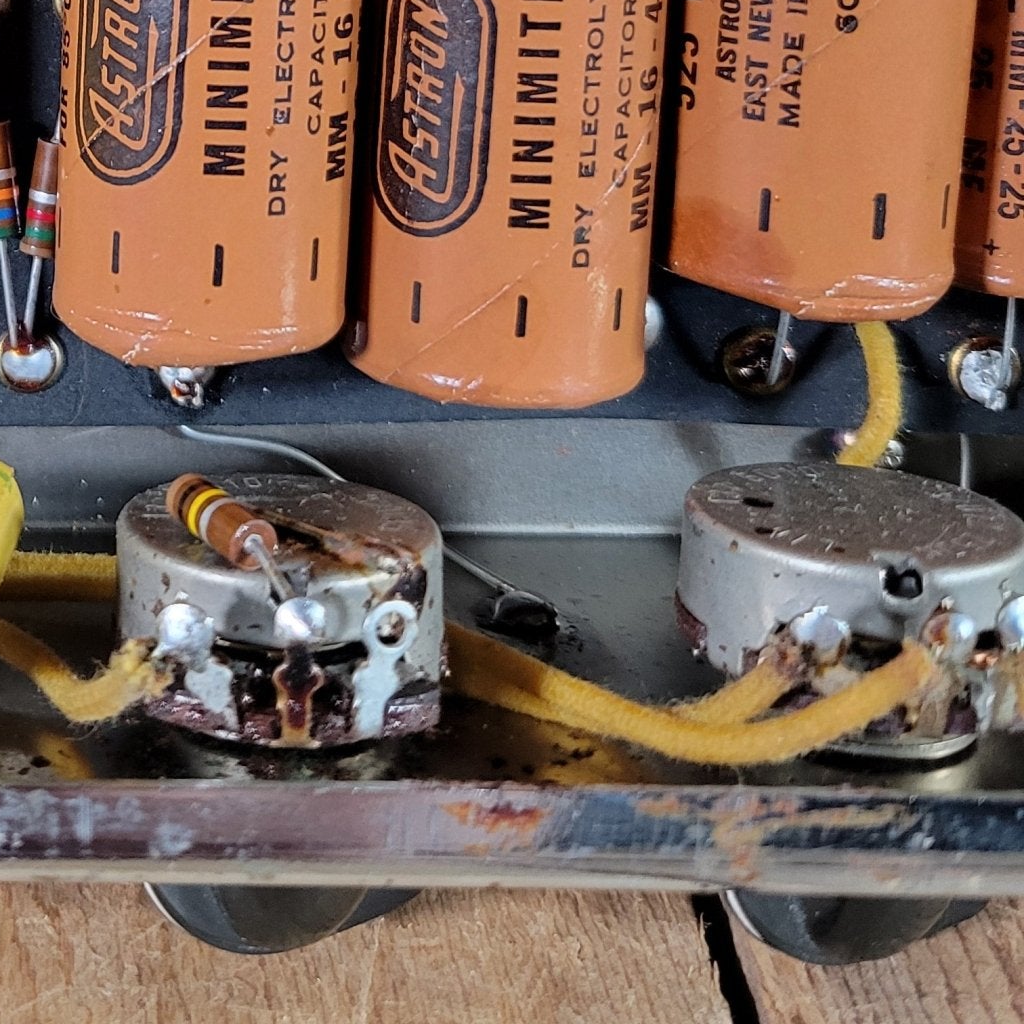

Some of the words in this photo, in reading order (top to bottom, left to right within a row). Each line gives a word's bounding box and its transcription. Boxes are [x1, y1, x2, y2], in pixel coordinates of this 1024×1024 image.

[742, 55, 769, 122] EAST
[778, 32, 805, 128] MADE
[268, 150, 289, 216] DRY
[572, 202, 593, 268] DRY
